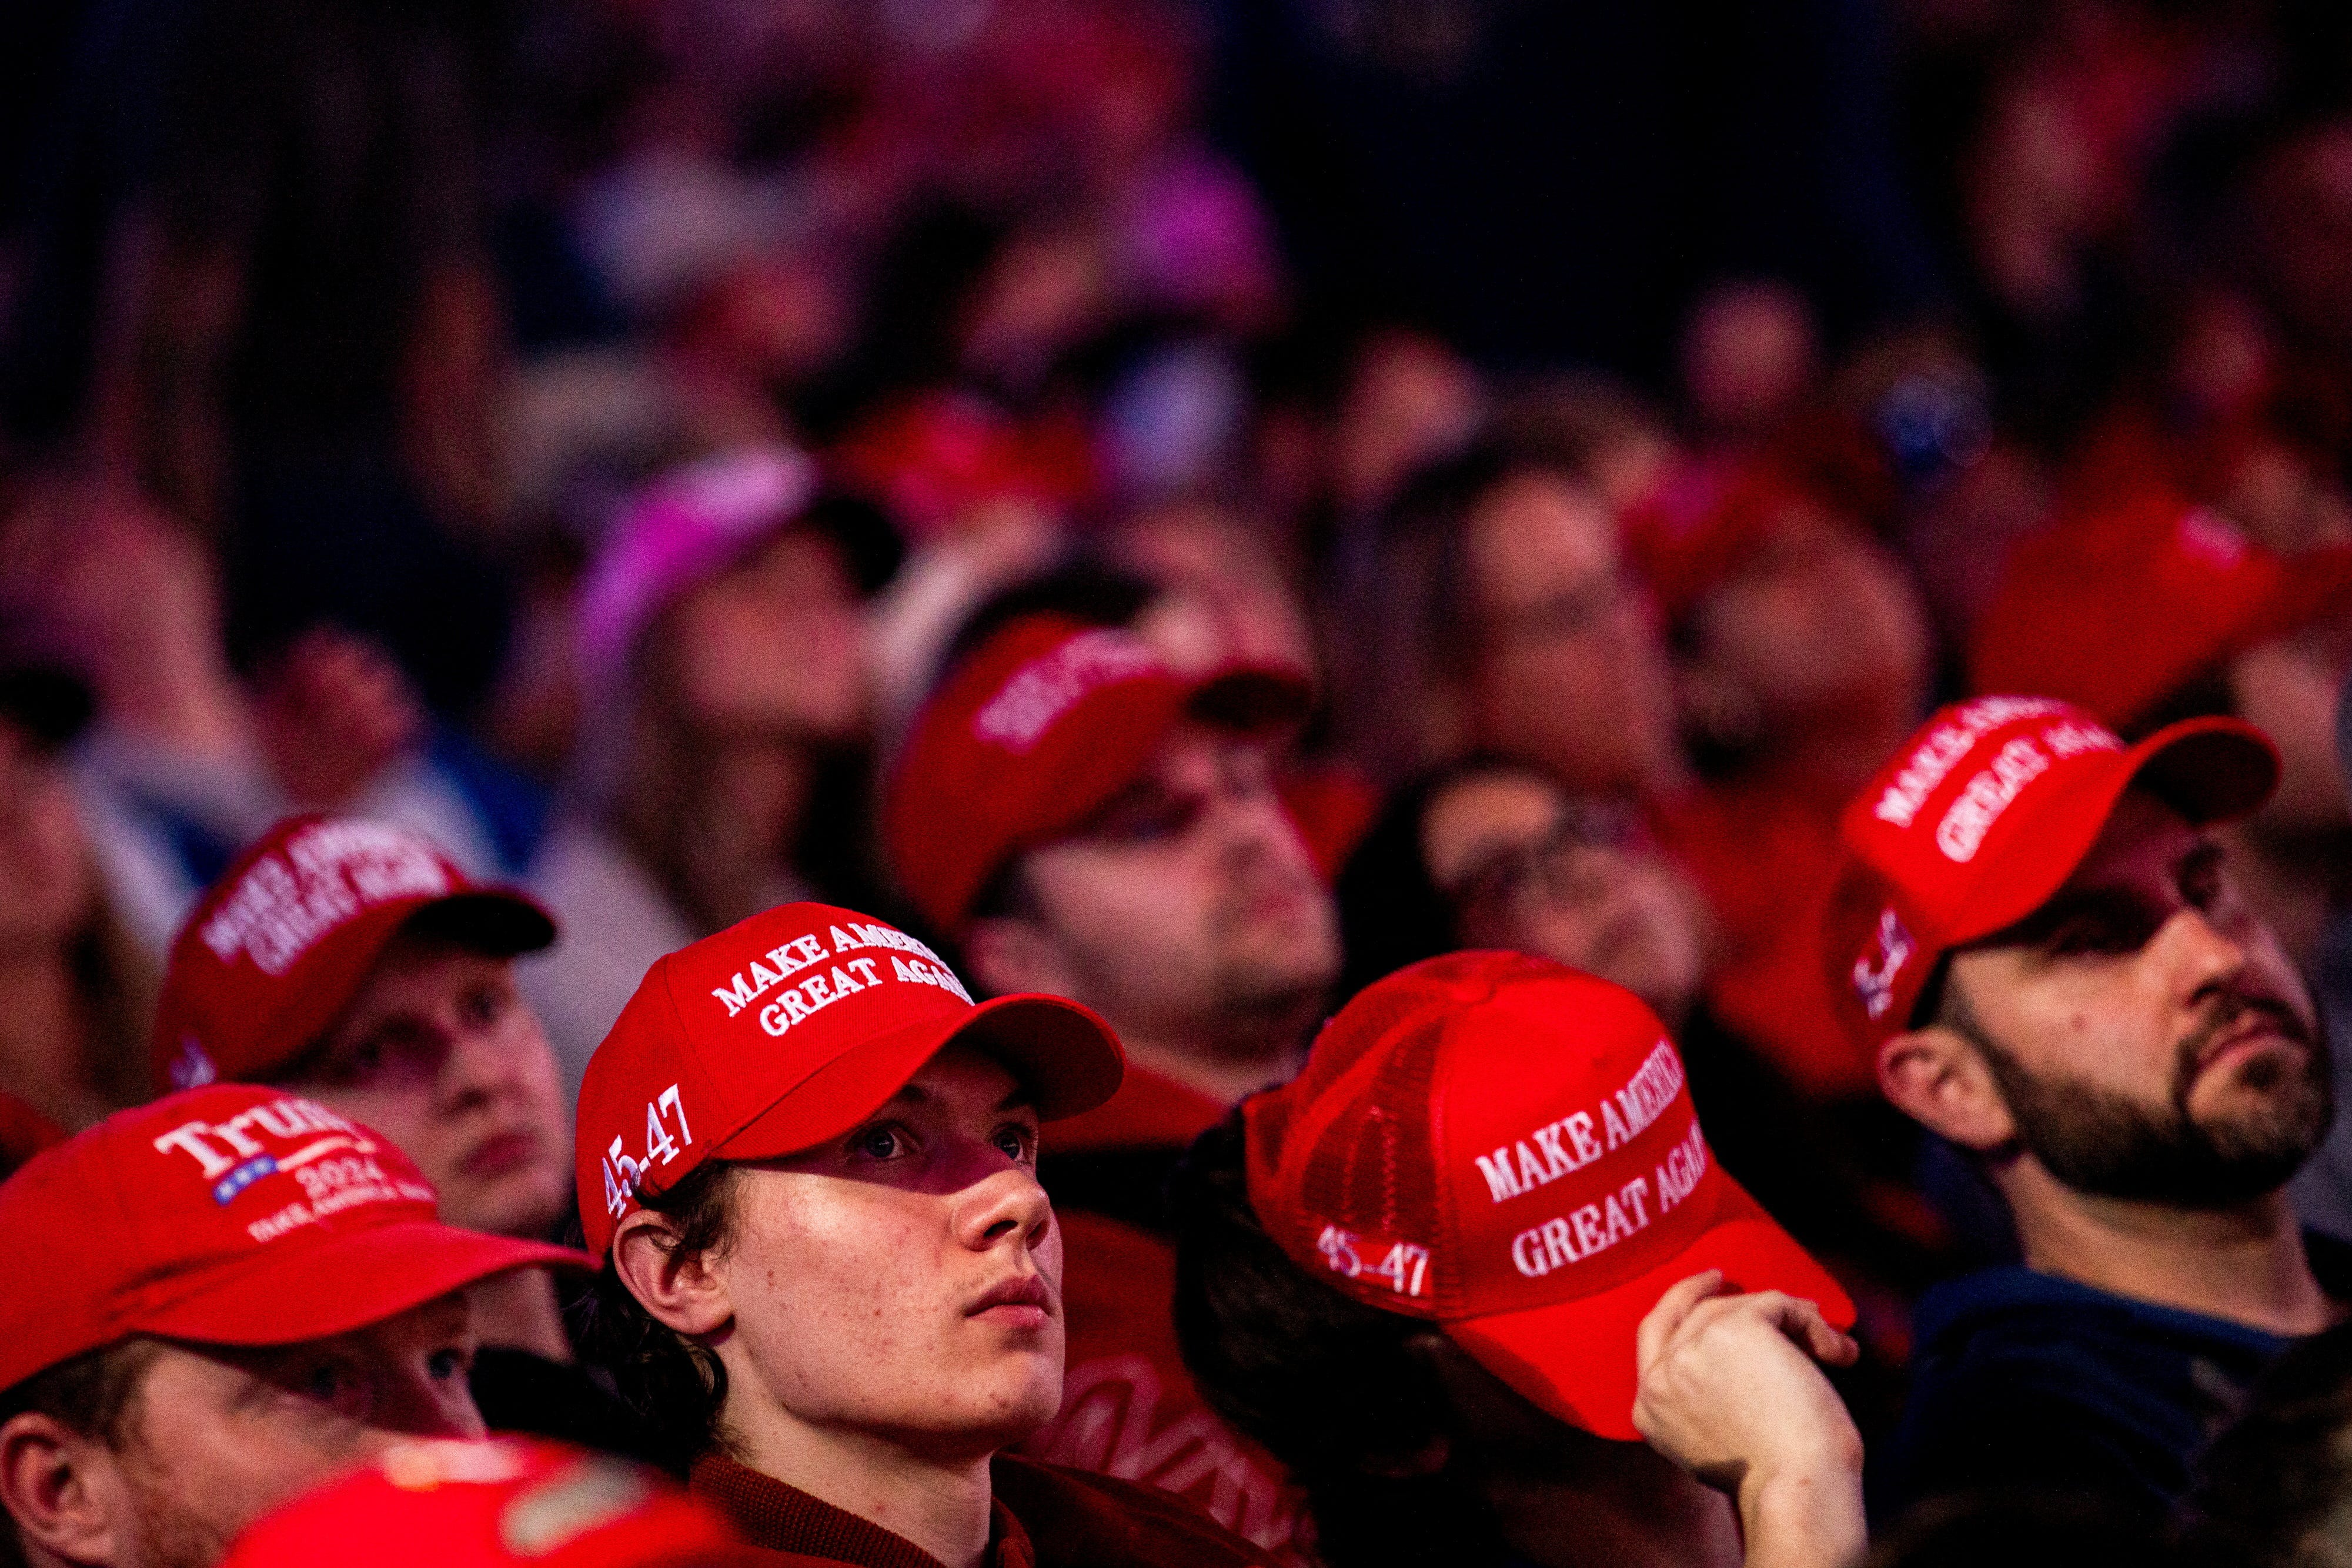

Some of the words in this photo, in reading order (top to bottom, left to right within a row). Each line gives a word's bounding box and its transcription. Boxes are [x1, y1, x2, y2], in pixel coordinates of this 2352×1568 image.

[1936, 736, 2051, 863] GREAT
[711, 934, 830, 1017] MAKE
[760, 957, 883, 1037] GREAT
[153, 1100, 360, 1179] Trum
[602, 1082, 692, 1219] 45-47
[1475, 1111, 1603, 1203] MAKE
[1317, 1224, 1430, 1297] 45-47
[1512, 1176, 1651, 1278] GREAT
